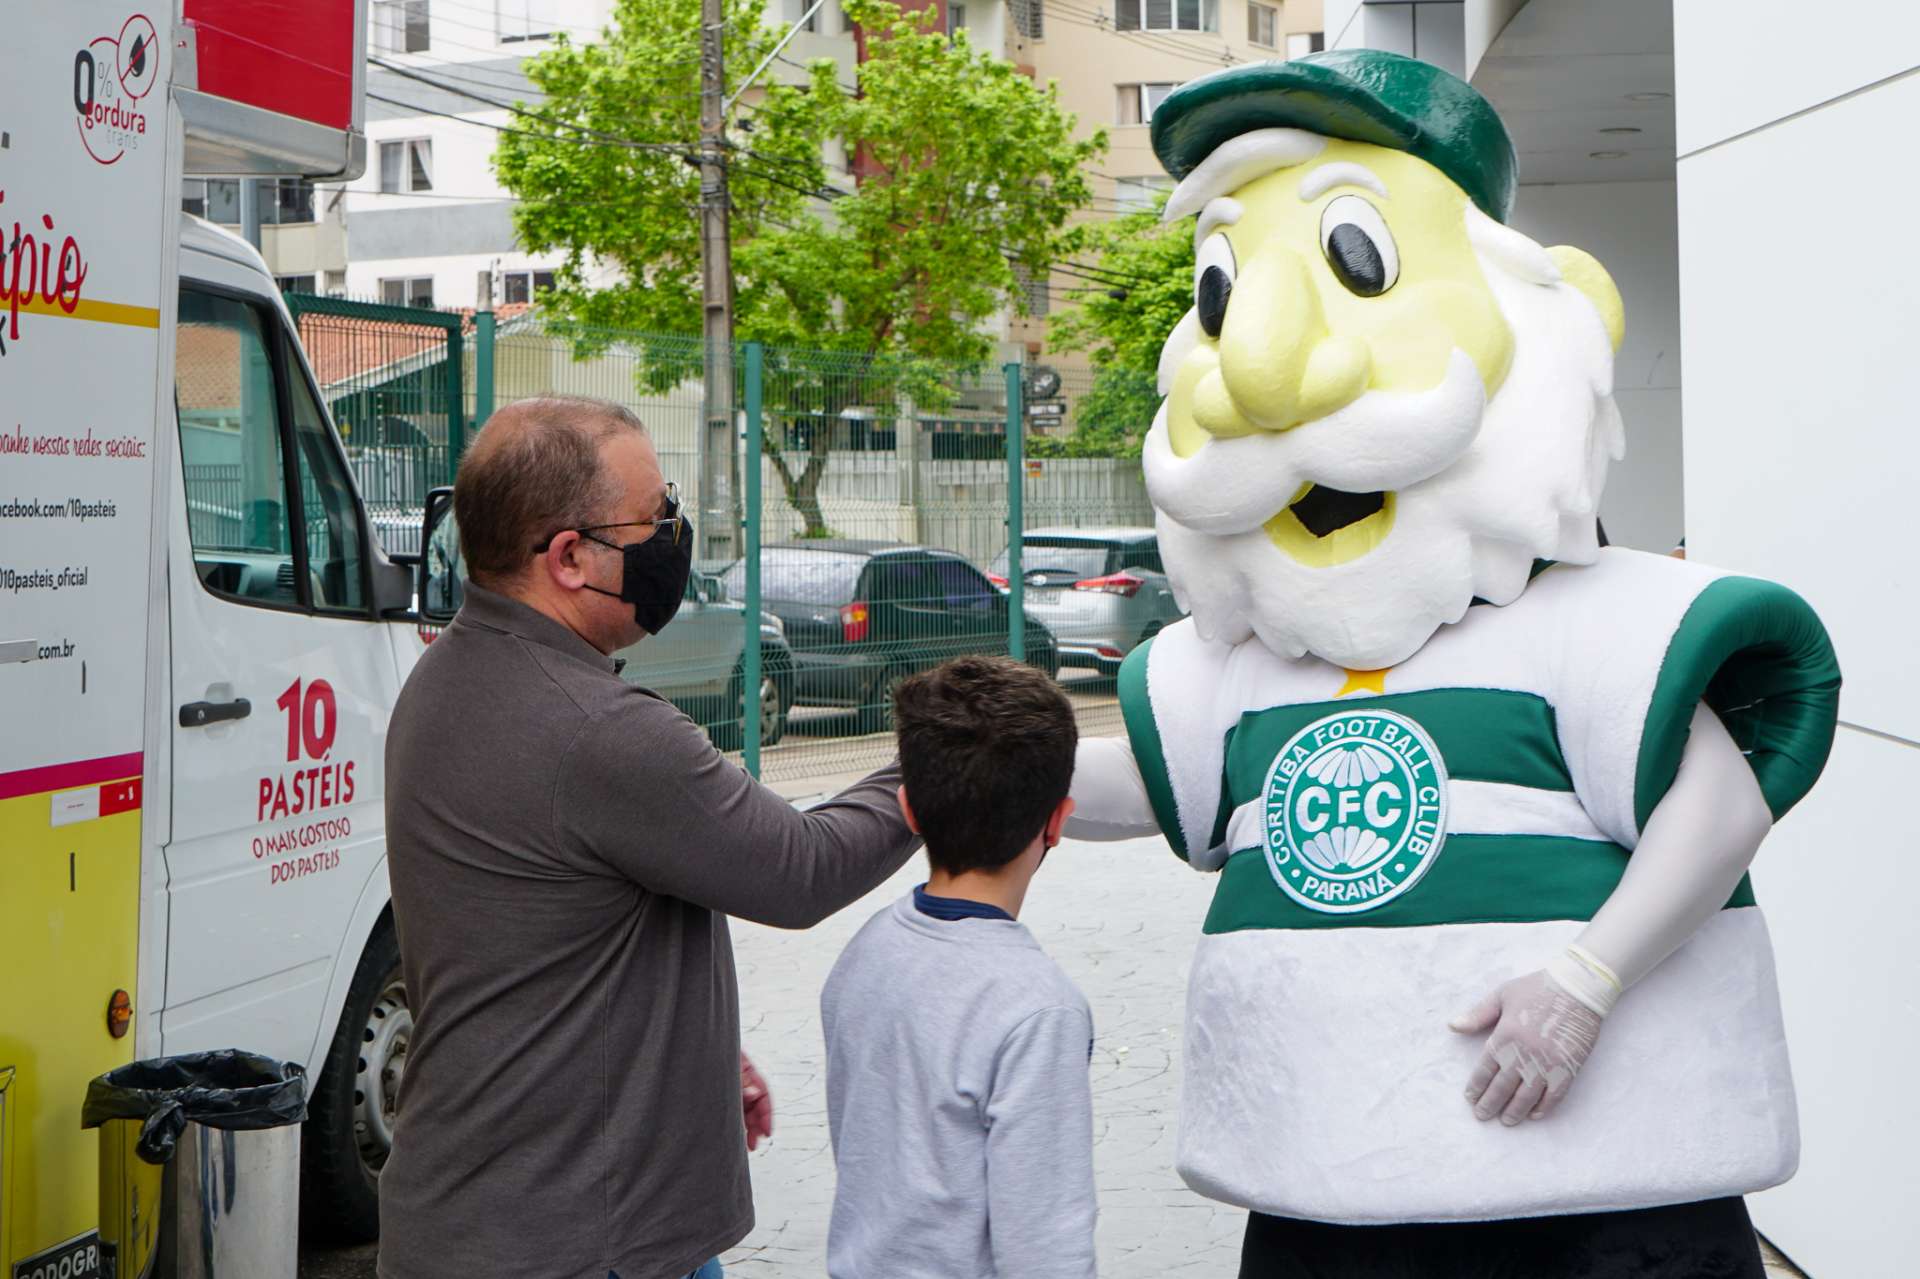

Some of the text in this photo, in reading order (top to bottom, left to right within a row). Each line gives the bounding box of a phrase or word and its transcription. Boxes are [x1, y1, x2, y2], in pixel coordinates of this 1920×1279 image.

[85, 98, 145, 134] gordura
[106, 123, 138, 150] trans
[0, 423, 146, 458] anhe nossas redes sociais:
[0, 497, 116, 522] cebook.com/10pasteis
[276, 676, 337, 762] 10
[258, 754, 355, 822] PASTÉIS
[1268, 718, 1439, 865] CORITIBA FOOTBALL CLUB
[1295, 781, 1402, 833] CFC
[253, 817, 350, 859] O MAIS GOSTOSO
[272, 860, 295, 884] DOS
[1301, 868, 1396, 902] PARANÁ
